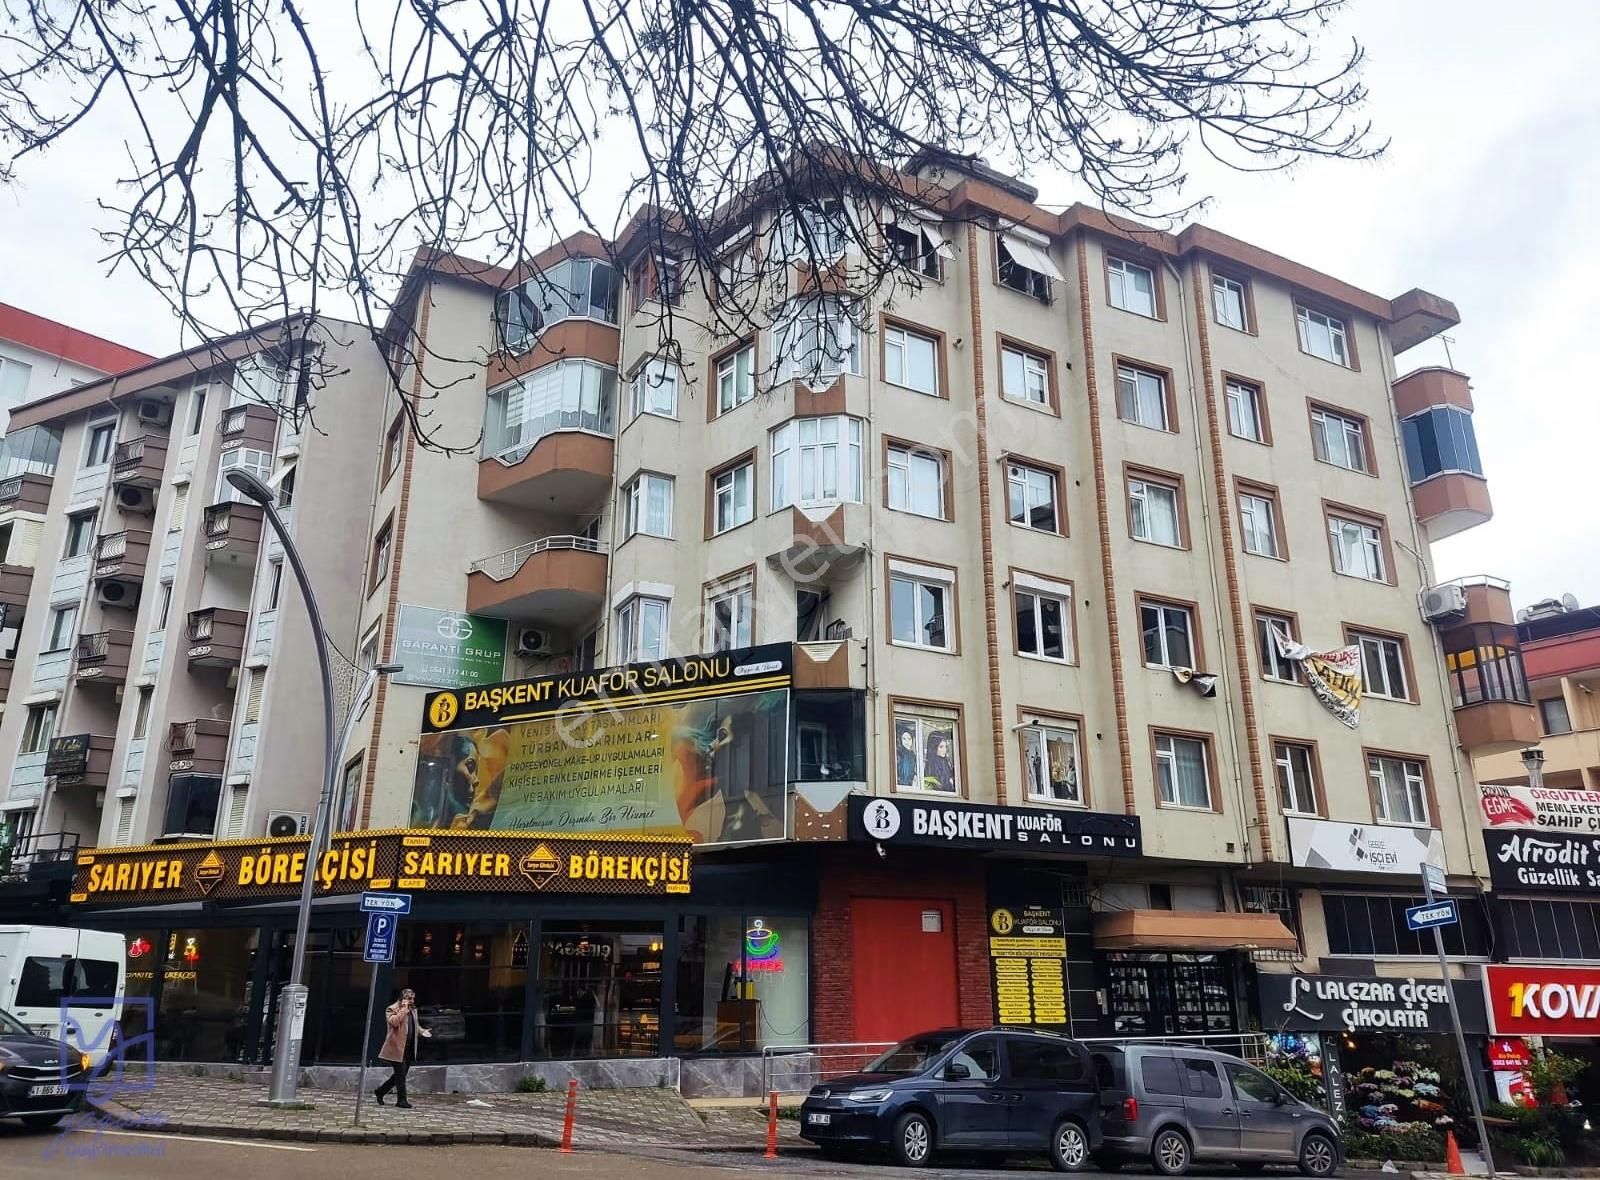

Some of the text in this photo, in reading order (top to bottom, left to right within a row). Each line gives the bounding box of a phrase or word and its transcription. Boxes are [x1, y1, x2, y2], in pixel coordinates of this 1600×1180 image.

[402, 639, 460, 655] GARANTİ
[465, 647, 501, 658] GRUP
[464, 681, 554, 713] BAŞKENT
[558, 667, 638, 699] KUAFÖR
[643, 657, 730, 688] SALONU
[510, 747, 665, 773] PROFESYONEL MAKE-UP UYGULAMALARI
[509, 765, 664, 789] KİŞİSEL RENKLENDİRME İŞLEMLERİ
[523, 782, 645, 804] VE BAKIM UYGULAMALARI
[913, 808, 1063, 840] BAŞKENT KUAFÖR
[1017, 831, 1136, 848] SALONU
[1497, 834, 1590, 866] Afrodit
[88, 860, 184, 893] SARIYER
[404, 850, 690, 887] SARIYER BÖREKÇİSİ
[1517, 867, 1581, 887] Güzellik
[377, 918, 387, 933] P
[1421, 909, 1450, 920] TEK YÖN
[1315, 981, 1396, 1002] LALEZAR
[1341, 1001, 1429, 1033] ÇİKOLATA
